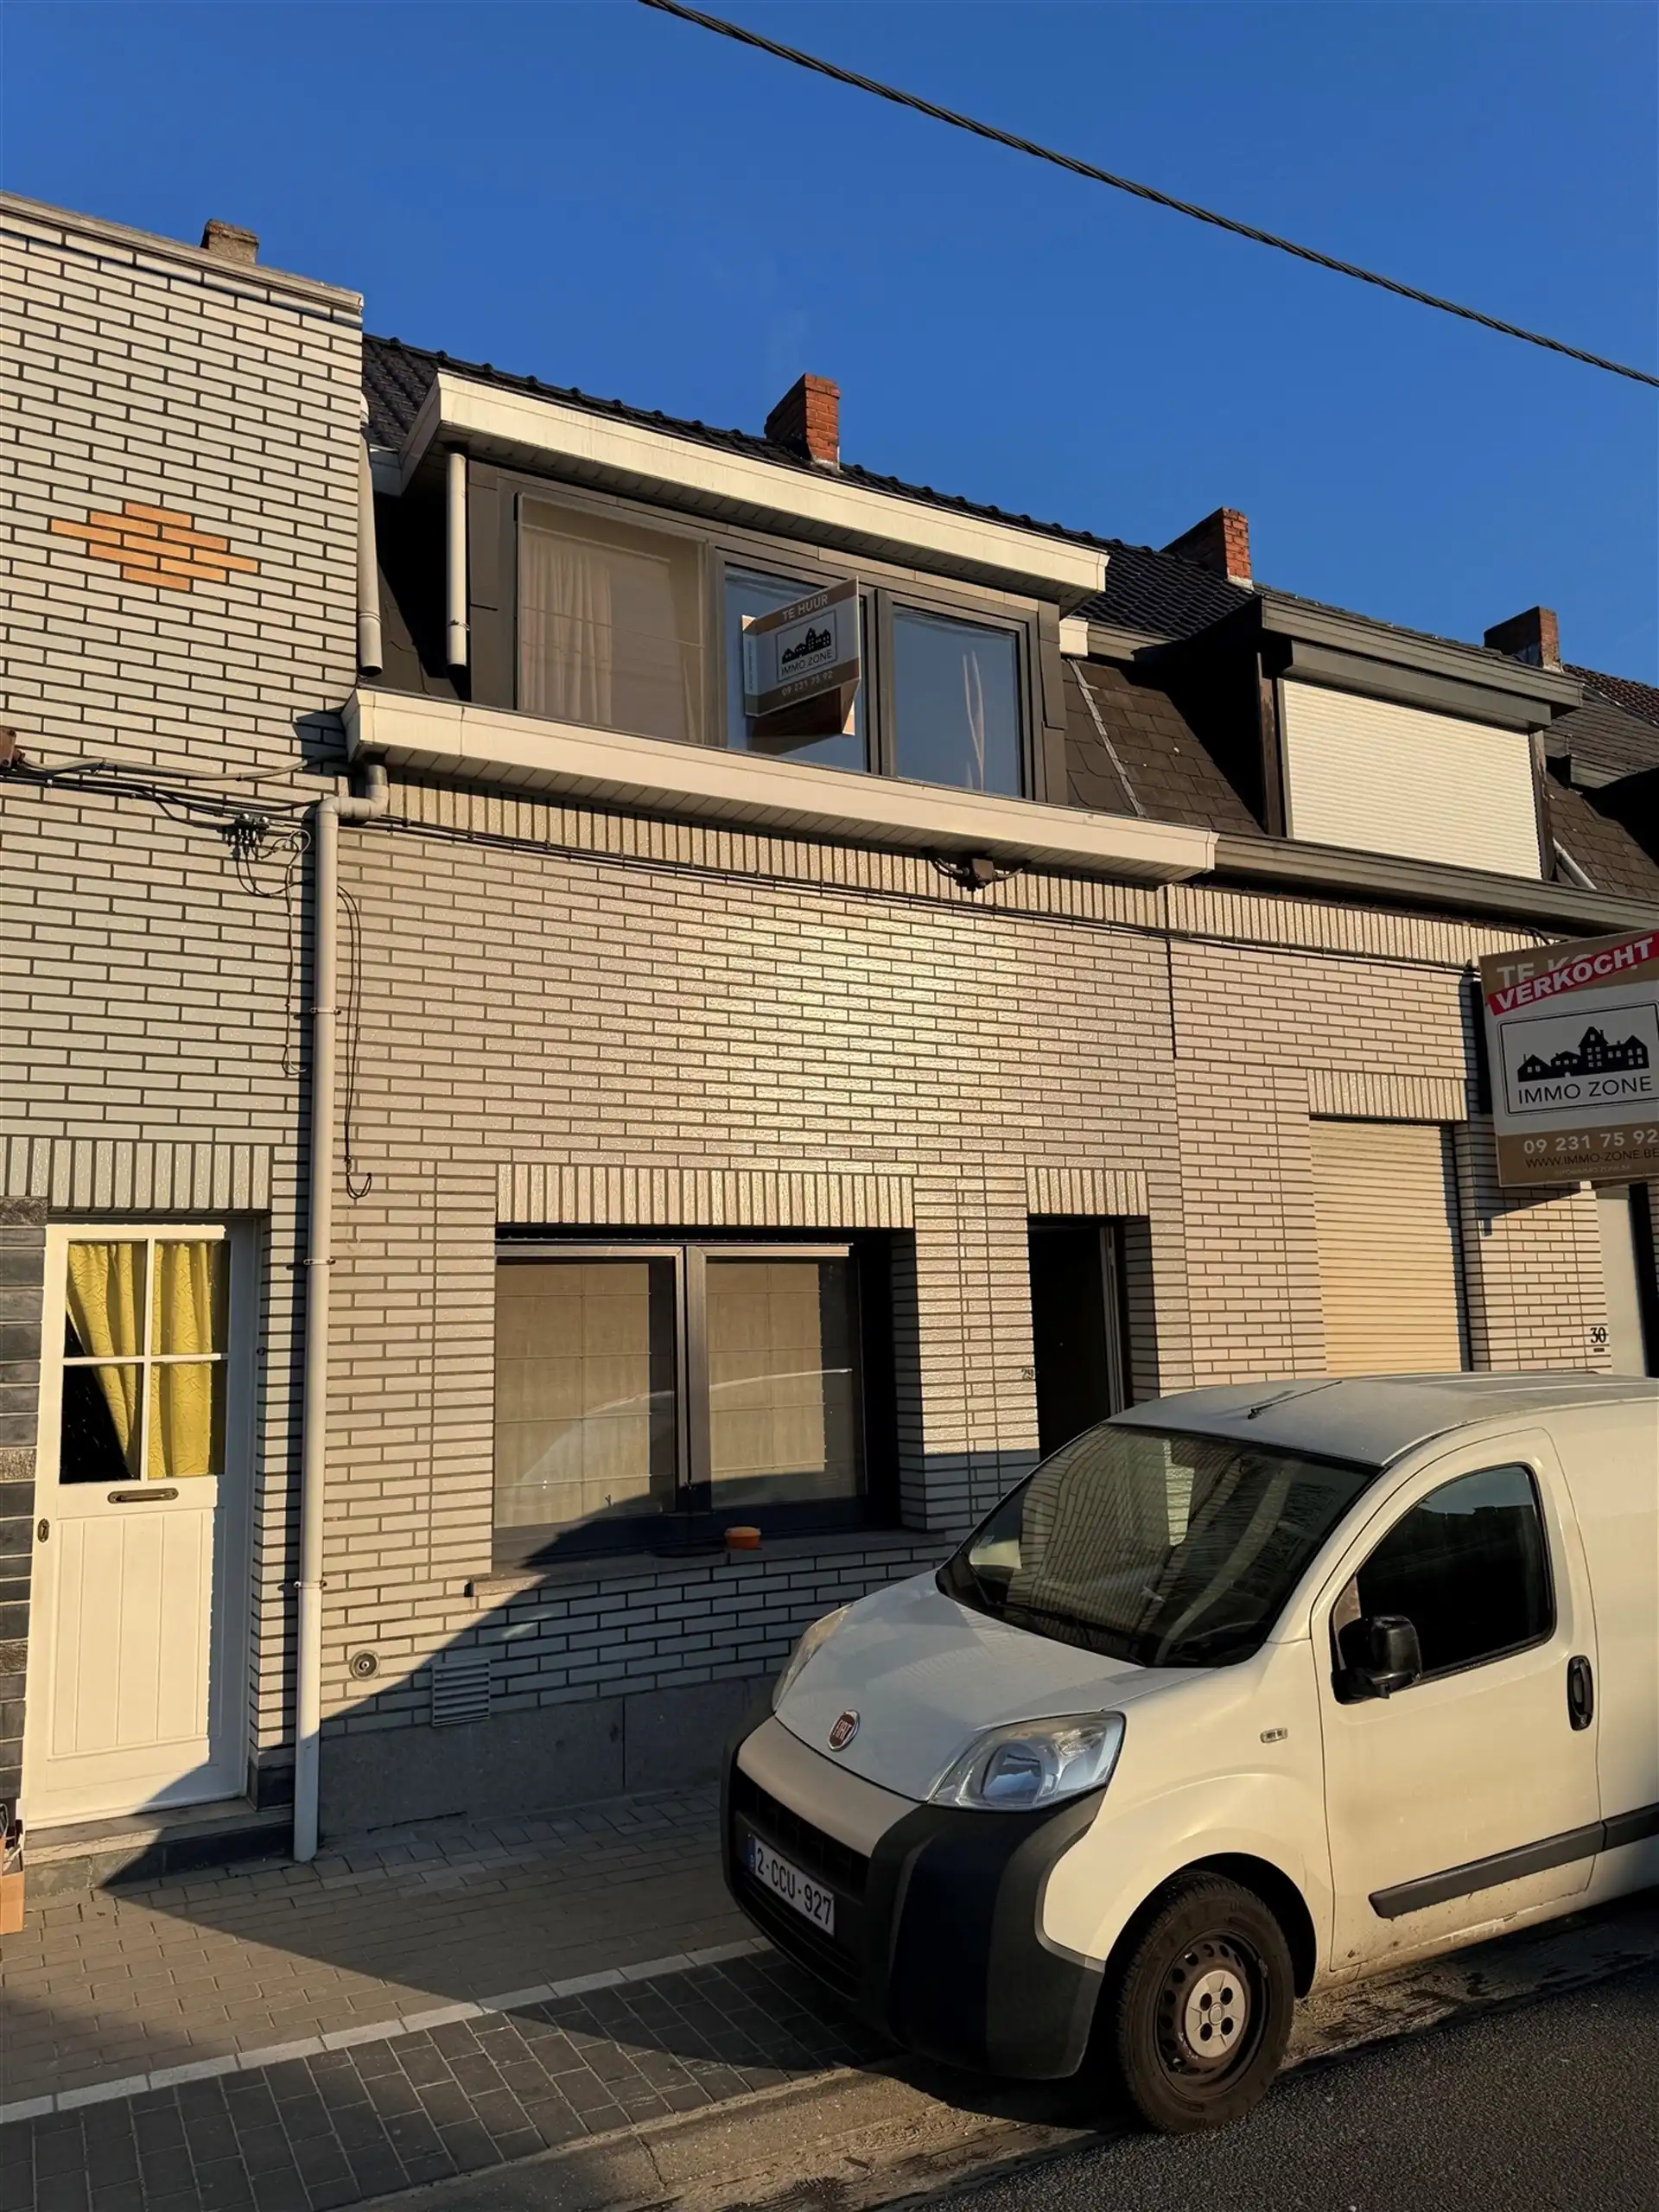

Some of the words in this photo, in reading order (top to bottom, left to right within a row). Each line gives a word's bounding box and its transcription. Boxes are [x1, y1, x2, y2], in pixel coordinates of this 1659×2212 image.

[782, 607, 796, 621] TE
[798, 594, 829, 615] HUUR
[781, 659, 805, 677] IMMO
[808, 649, 832, 665] ZONE
[1496, 937, 1655, 1010] VERKOCHT
[1518, 1083, 1581, 1105] IMMO
[1587, 1075, 1653, 1097] ZONE
[1523, 1138, 1548, 1154] 09
[1554, 1134, 1591, 1152] 231
[1599, 1131, 1624, 1148] 75
[1632, 1128, 1659, 1145] 92
[1524, 1147, 1659, 1168] WWW.IMMO-ZONE.BE
[1590, 1326, 1607, 1344] 30
